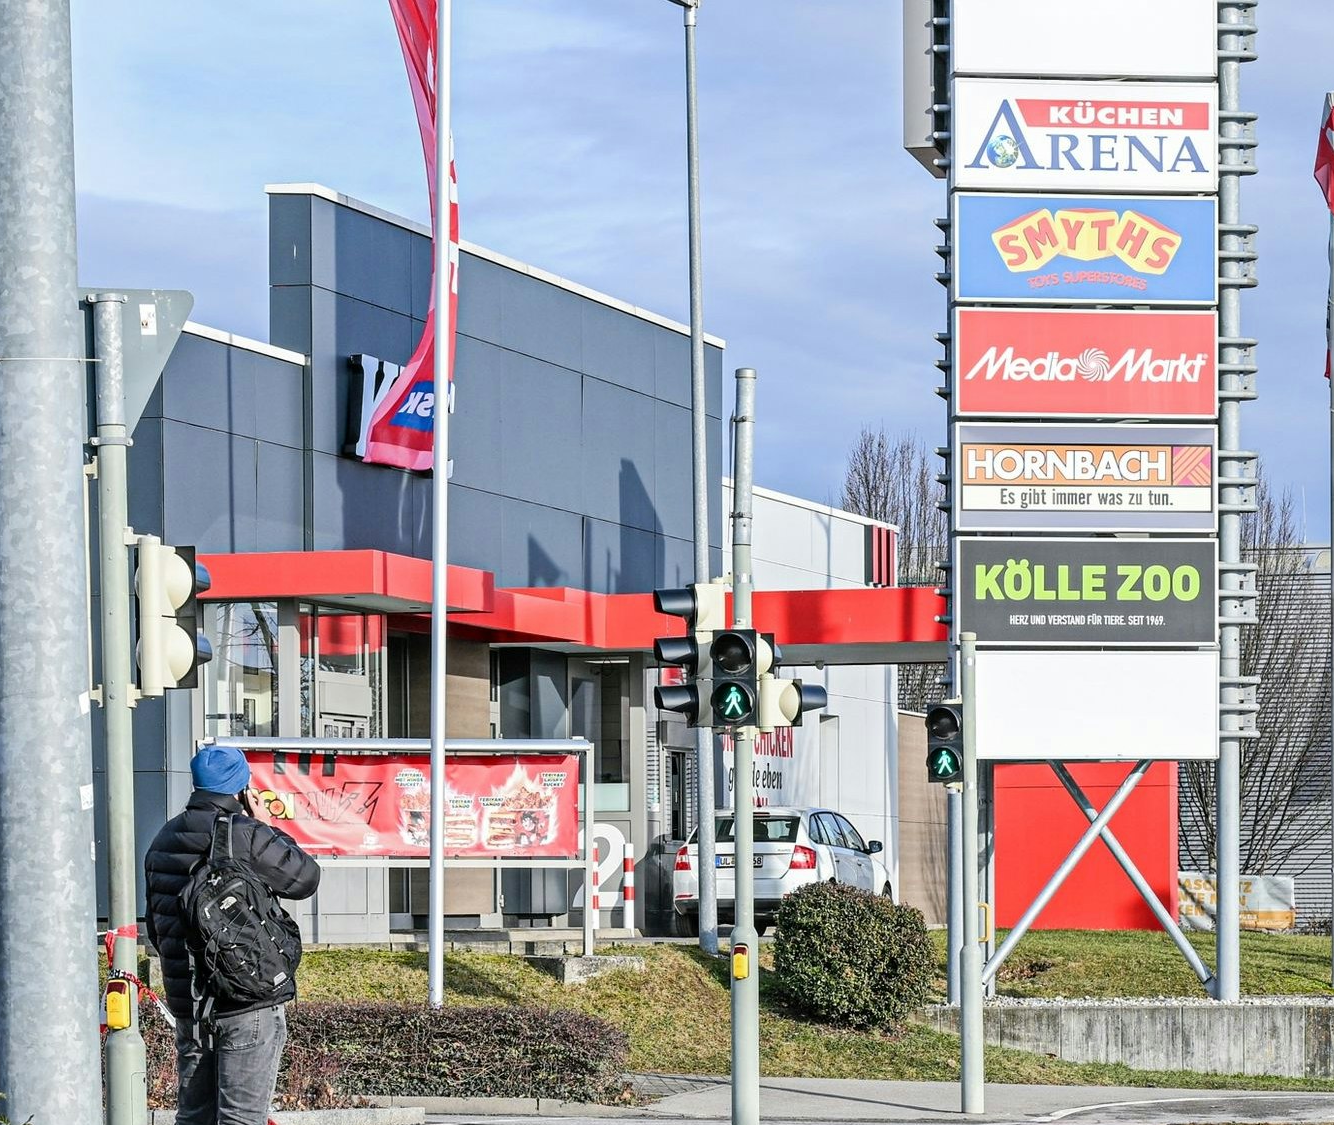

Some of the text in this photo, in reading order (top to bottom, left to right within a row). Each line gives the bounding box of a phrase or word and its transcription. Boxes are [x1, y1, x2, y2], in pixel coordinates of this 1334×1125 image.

[1049, 101, 1184, 126] KÜCHEN
[964, 98, 1210, 173] ARENA
[998, 217, 1177, 269] SMYTHS
[1027, 271, 1148, 291] TOYS SUPERSTORES
[964, 346, 1207, 383] Media Markt
[967, 448, 1167, 482] HORNBACH
[1000, 488, 1174, 508] Es gibt immer was zu tun.
[975, 558, 1201, 602] KÖLLE ZOO
[1009, 613, 1166, 626] HERZ UND VERSTAND FÜR TIERE. SEIT 1969.
[762, 763, 783, 790] eben
